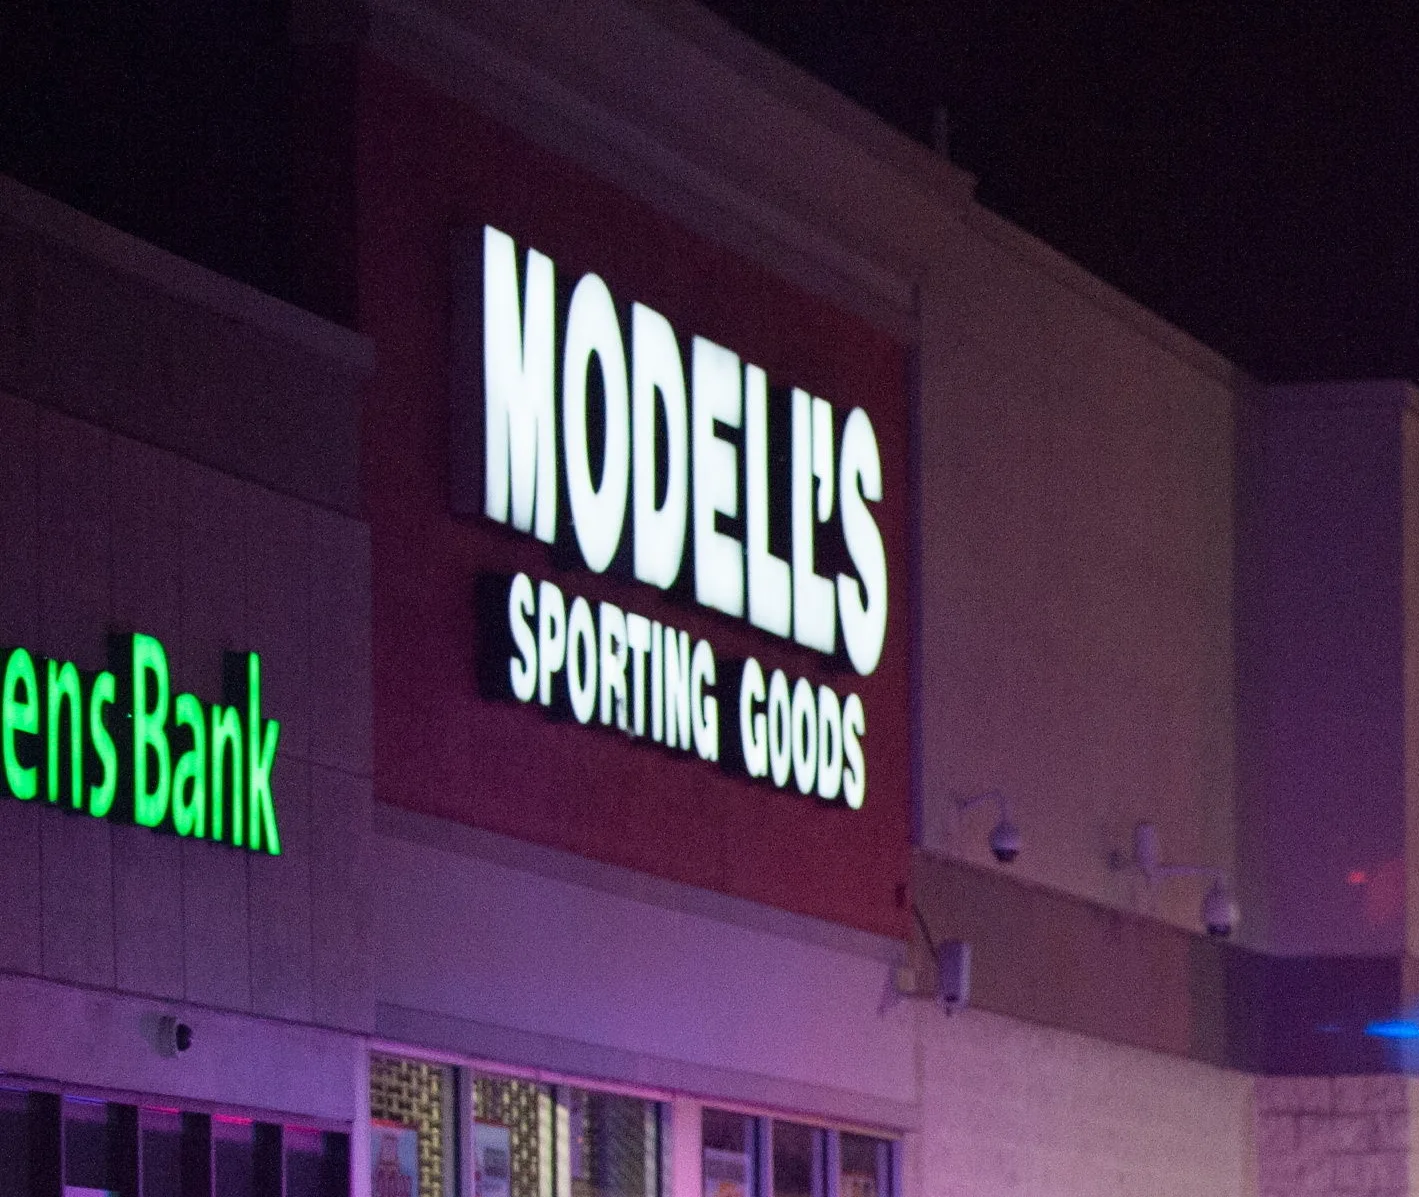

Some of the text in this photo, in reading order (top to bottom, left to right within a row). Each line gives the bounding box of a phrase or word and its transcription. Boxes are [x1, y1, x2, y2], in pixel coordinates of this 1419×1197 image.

[483, 224, 888, 677] MODELL'S
[508, 571, 867, 810] SPORTING GOODS
